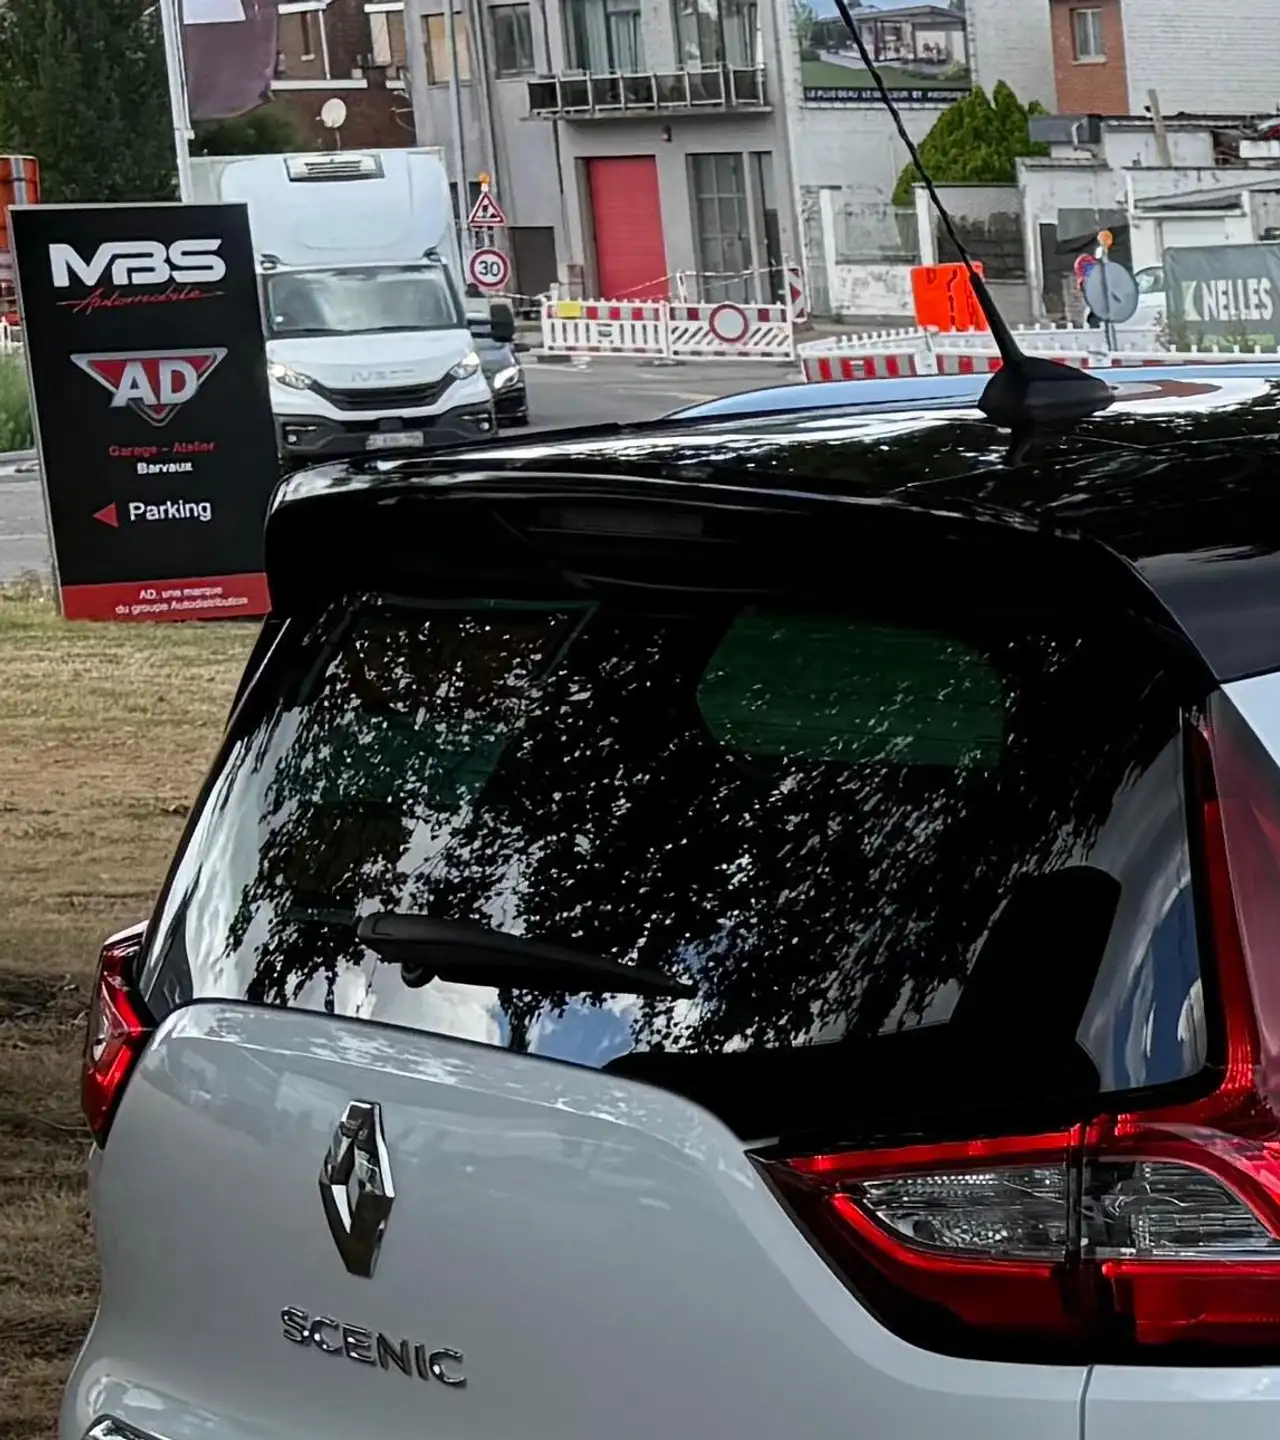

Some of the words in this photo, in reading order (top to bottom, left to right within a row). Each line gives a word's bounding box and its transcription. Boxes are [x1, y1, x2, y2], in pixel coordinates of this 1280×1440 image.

[48, 238, 227, 288] MBS
[478, 261, 501, 277] 30
[1202, 277, 1274, 322] NELLES
[109, 358, 199, 409] AD
[109, 444, 159, 458] Garage
[173, 440, 216, 454] Atelier
[136, 461, 194, 475] Barvaux
[128, 499, 213, 523] Parking
[162, 588, 182, 599] une
[183, 585, 223, 598] marque
[131, 602, 169, 616] groupe
[280, 1304, 468, 1390] SCENIC
